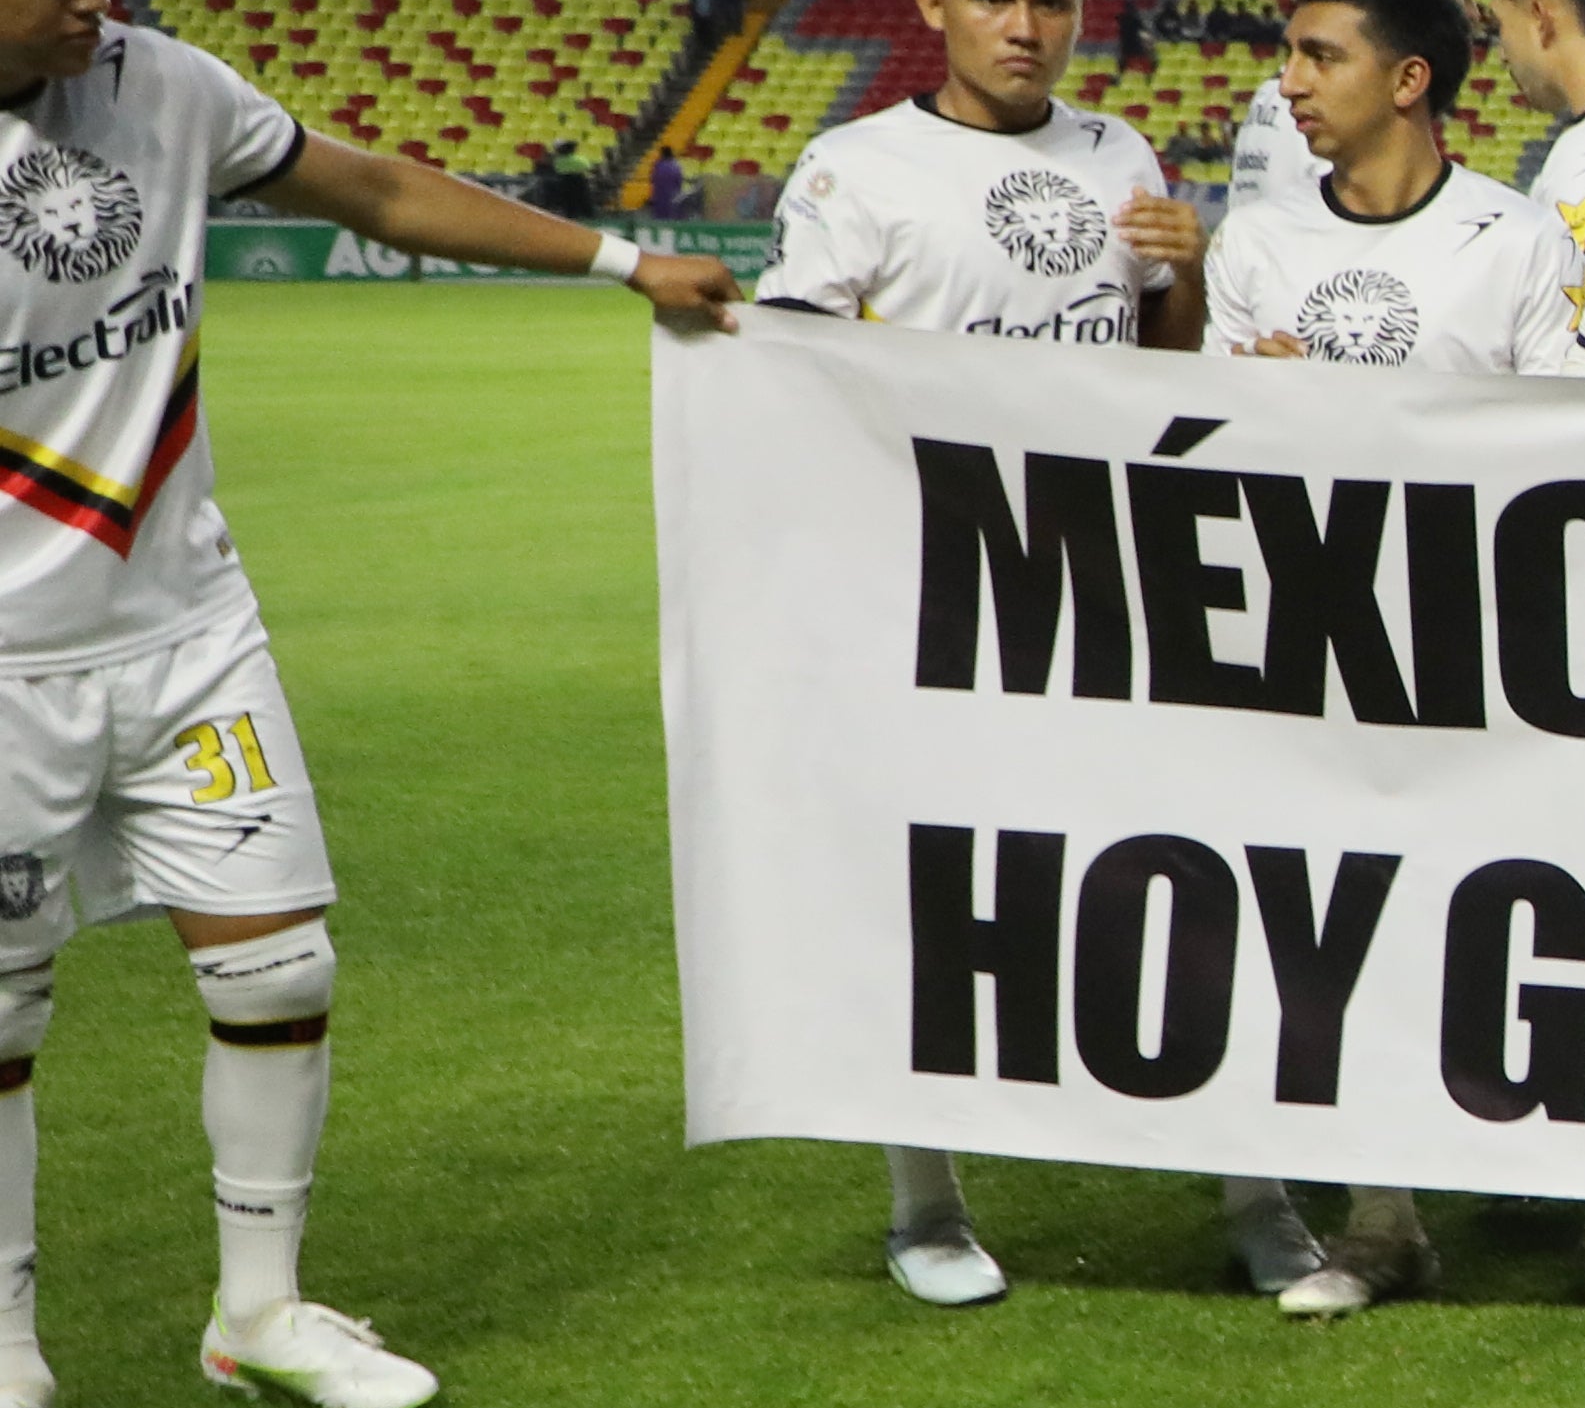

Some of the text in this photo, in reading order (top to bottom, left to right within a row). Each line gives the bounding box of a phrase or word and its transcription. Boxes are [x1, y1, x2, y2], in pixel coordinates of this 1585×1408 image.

[0, 281, 194, 394] Electroli
[175, 712, 278, 805] 31
[908, 822, 1404, 1107] HOY
